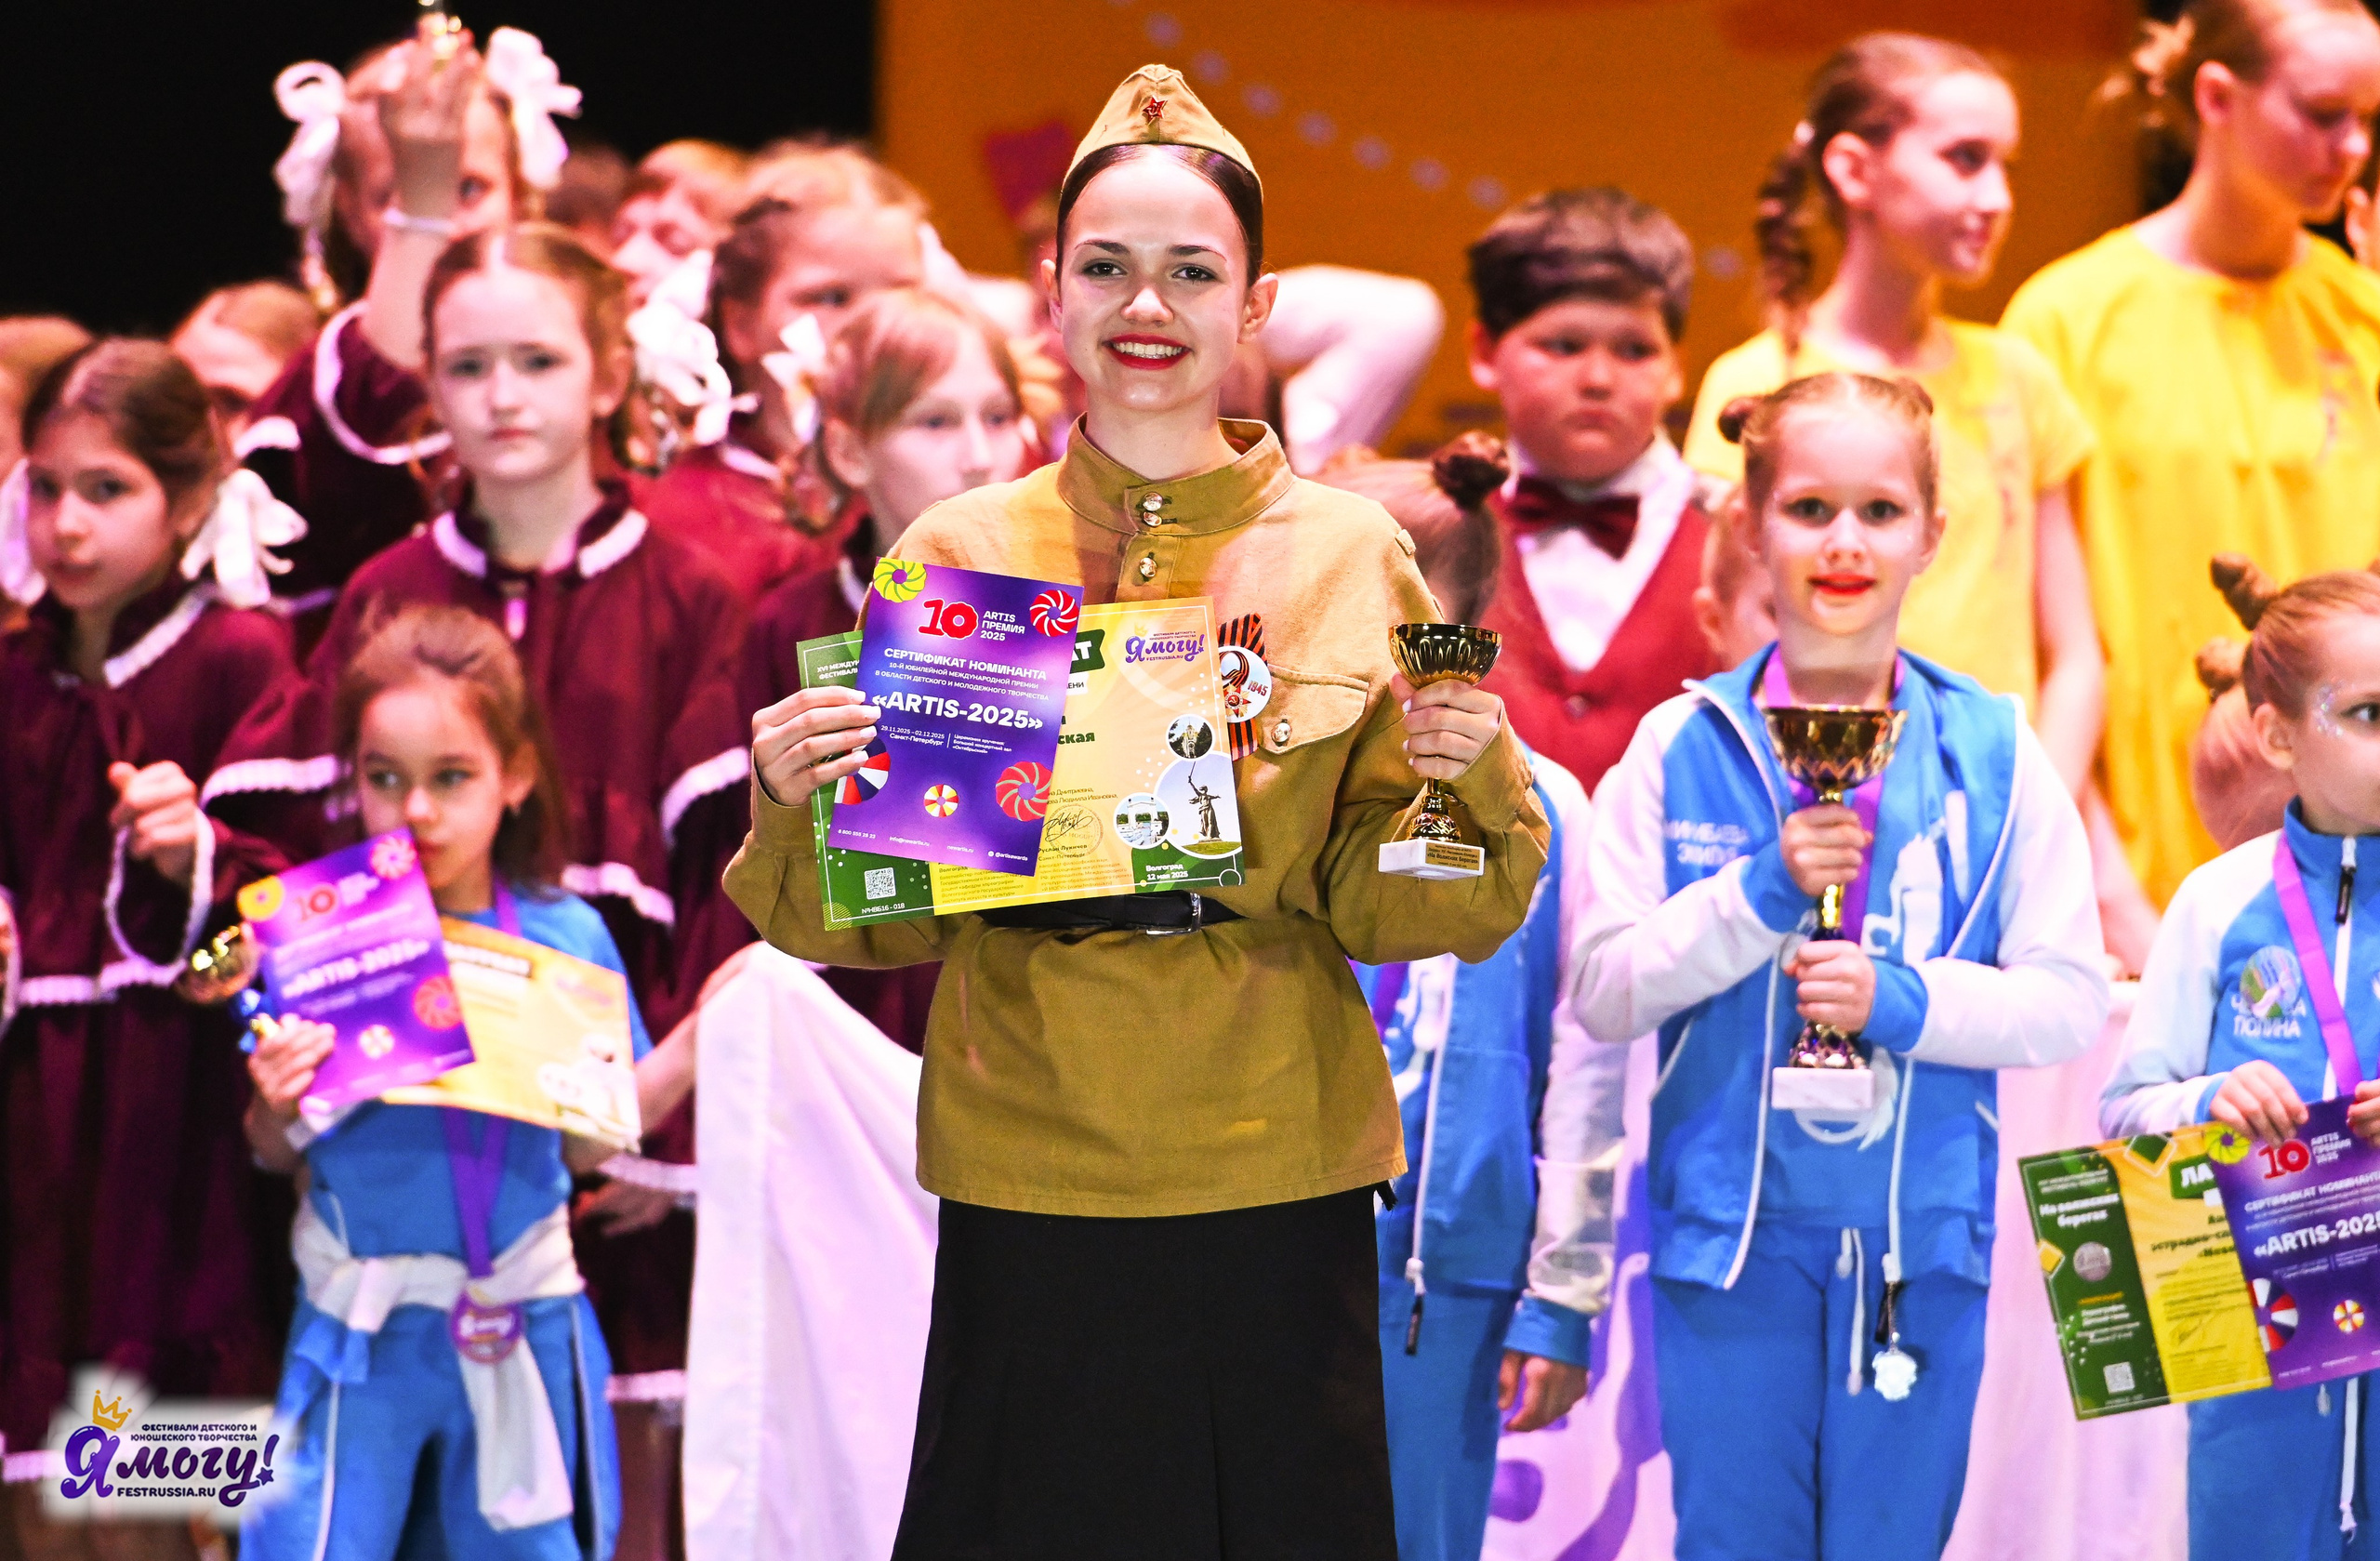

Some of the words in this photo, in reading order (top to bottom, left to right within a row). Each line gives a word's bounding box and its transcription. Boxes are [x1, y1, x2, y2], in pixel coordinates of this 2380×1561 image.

[918, 597, 979, 640] 10
[983, 610, 1016, 623] ARTIS
[982, 619, 1025, 635] ПРЕМИЯ
[980, 629, 1006, 642] 2025
[884, 647, 967, 668] СЕРТИФИКАТ
[969, 659, 1047, 681] НОМИНАНТА
[905, 664, 948, 677] ЮБИЛЕЙНОЙ
[948, 670, 1011, 685] МЕЖДУНАРОДНОЙ
[1011, 680, 1039, 690] ПРЕМИИ
[880, 670, 912, 681] ОБЛАСТИ
[912, 675, 946, 686] ДЕТСКОГО
[954, 681, 1007, 695] МОЛОДЕЖНОГО
[1007, 689, 1050, 701] ТВОРЧЕСТВА
[1248, 680, 1268, 696] 1945
[872, 691, 1044, 730] «ARTIS-2025»
[880, 725, 911, 734] 29.11.2025
[915, 730, 945, 739] 02.12.2025
[889, 733, 945, 746] Санкт-Петербург
[1059, 796, 1088, 804] Людмила
[889, 836, 930, 847] info@newartis.ru
[946, 844, 974, 853] newartis.ru
[1145, 864, 1183, 872] Волгоград
[1171, 870, 1189, 879] 2025
[2257, 1139, 2310, 1180] 10
